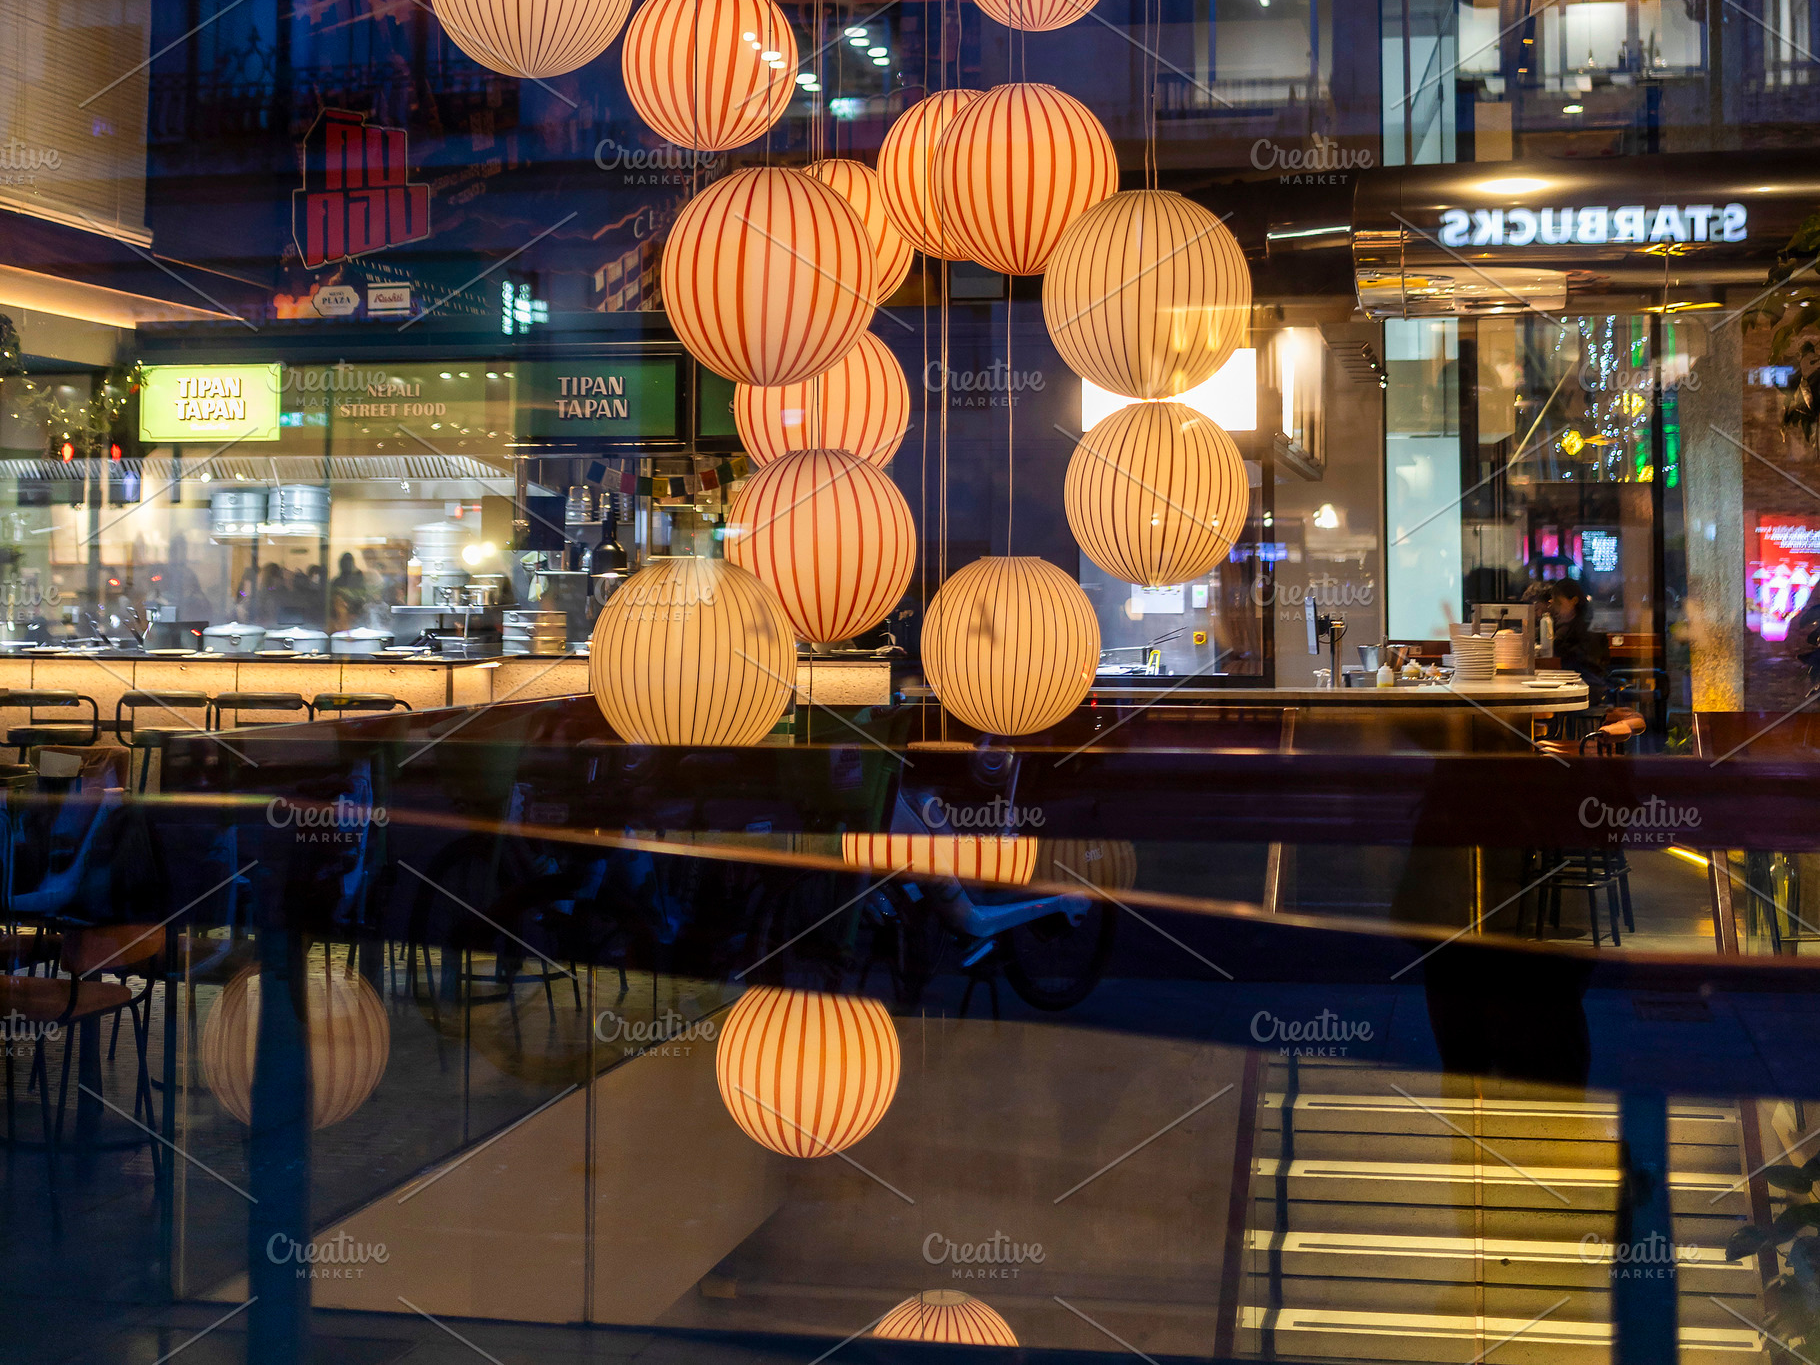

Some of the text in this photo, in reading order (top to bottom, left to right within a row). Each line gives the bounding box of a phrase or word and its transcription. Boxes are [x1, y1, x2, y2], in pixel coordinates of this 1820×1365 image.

[177, 377, 242, 399] TIPAN
[367, 383, 422, 399] NEPALI
[557, 376, 627, 397] TIPAN
[175, 399, 246, 421] TAPAN
[340, 401, 447, 418] STREET FOOD
[554, 398, 630, 420] TAPAN
